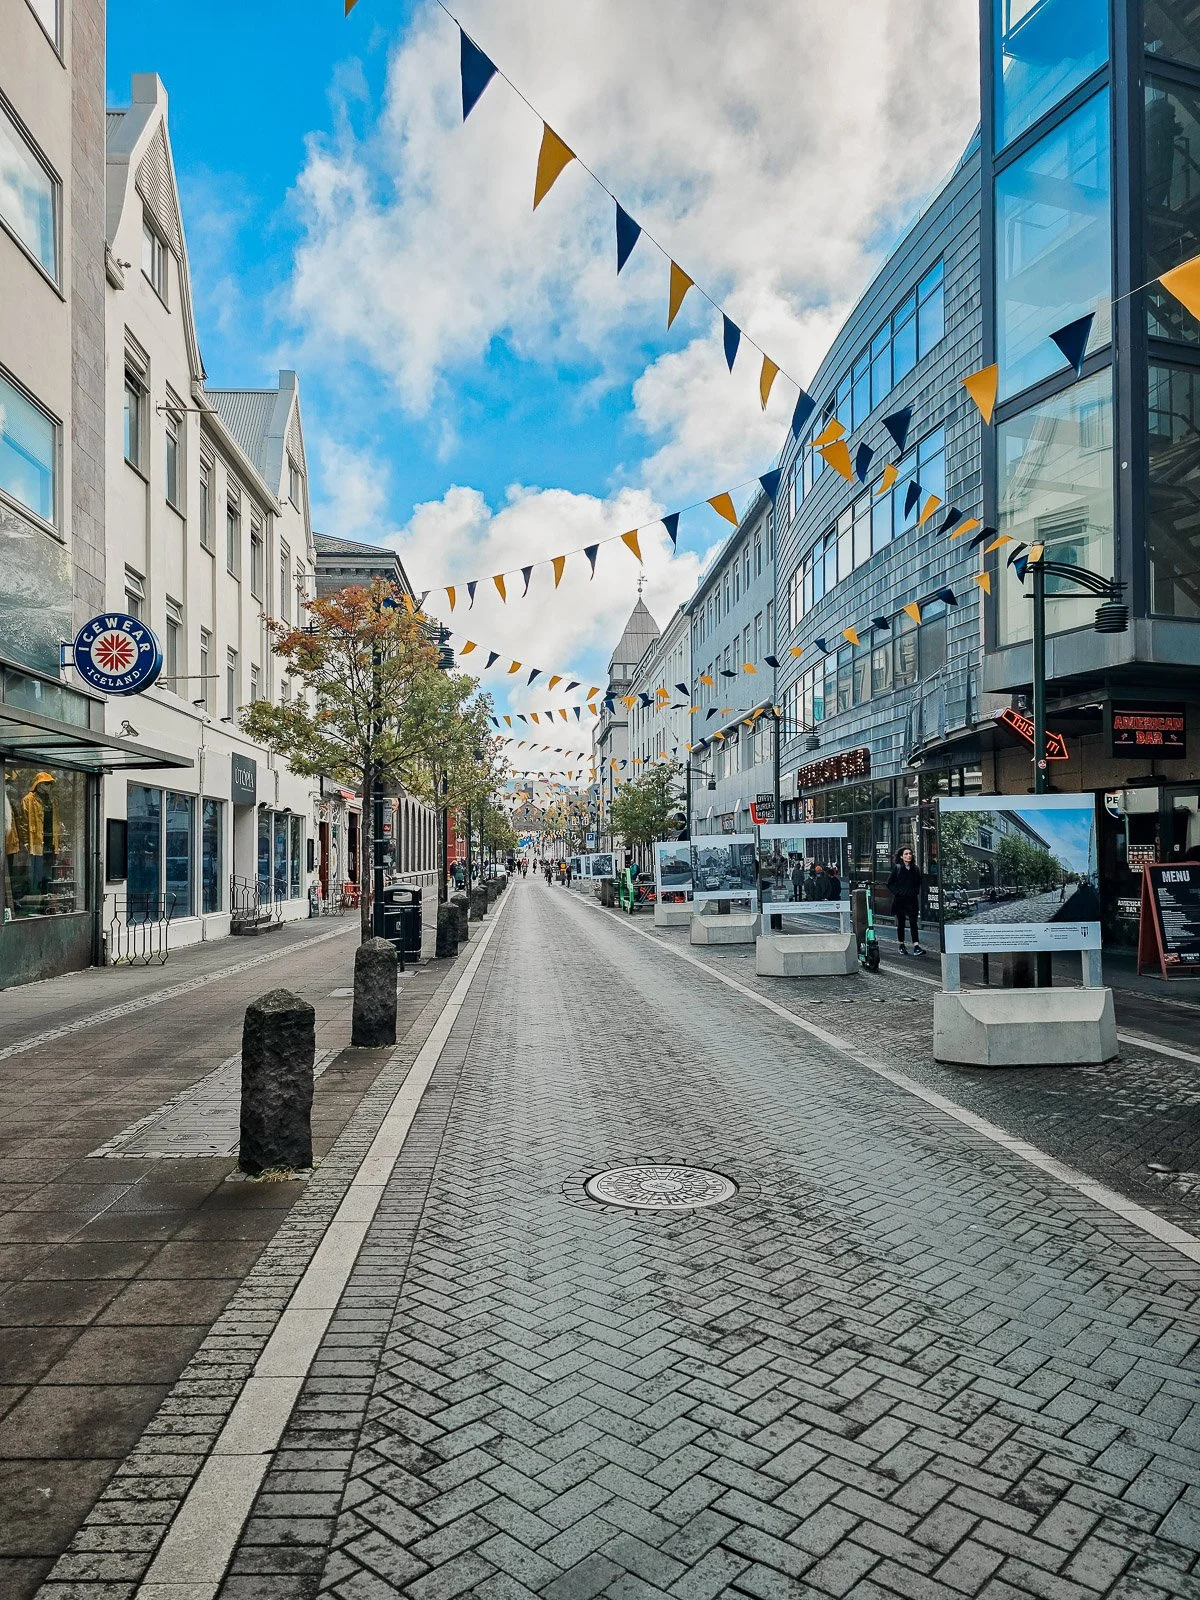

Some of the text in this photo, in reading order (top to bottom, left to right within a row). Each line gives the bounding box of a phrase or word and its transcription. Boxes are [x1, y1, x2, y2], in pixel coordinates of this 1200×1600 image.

[78, 617, 151, 653] ICEWEAR
[87, 668, 141, 687] ICELAND
[1011, 713, 1035, 736] THIS
[1113, 715, 1184, 731] AMERICAN
[1135, 731, 1164, 745] BAR
[1161, 870, 1191, 883] MENU
